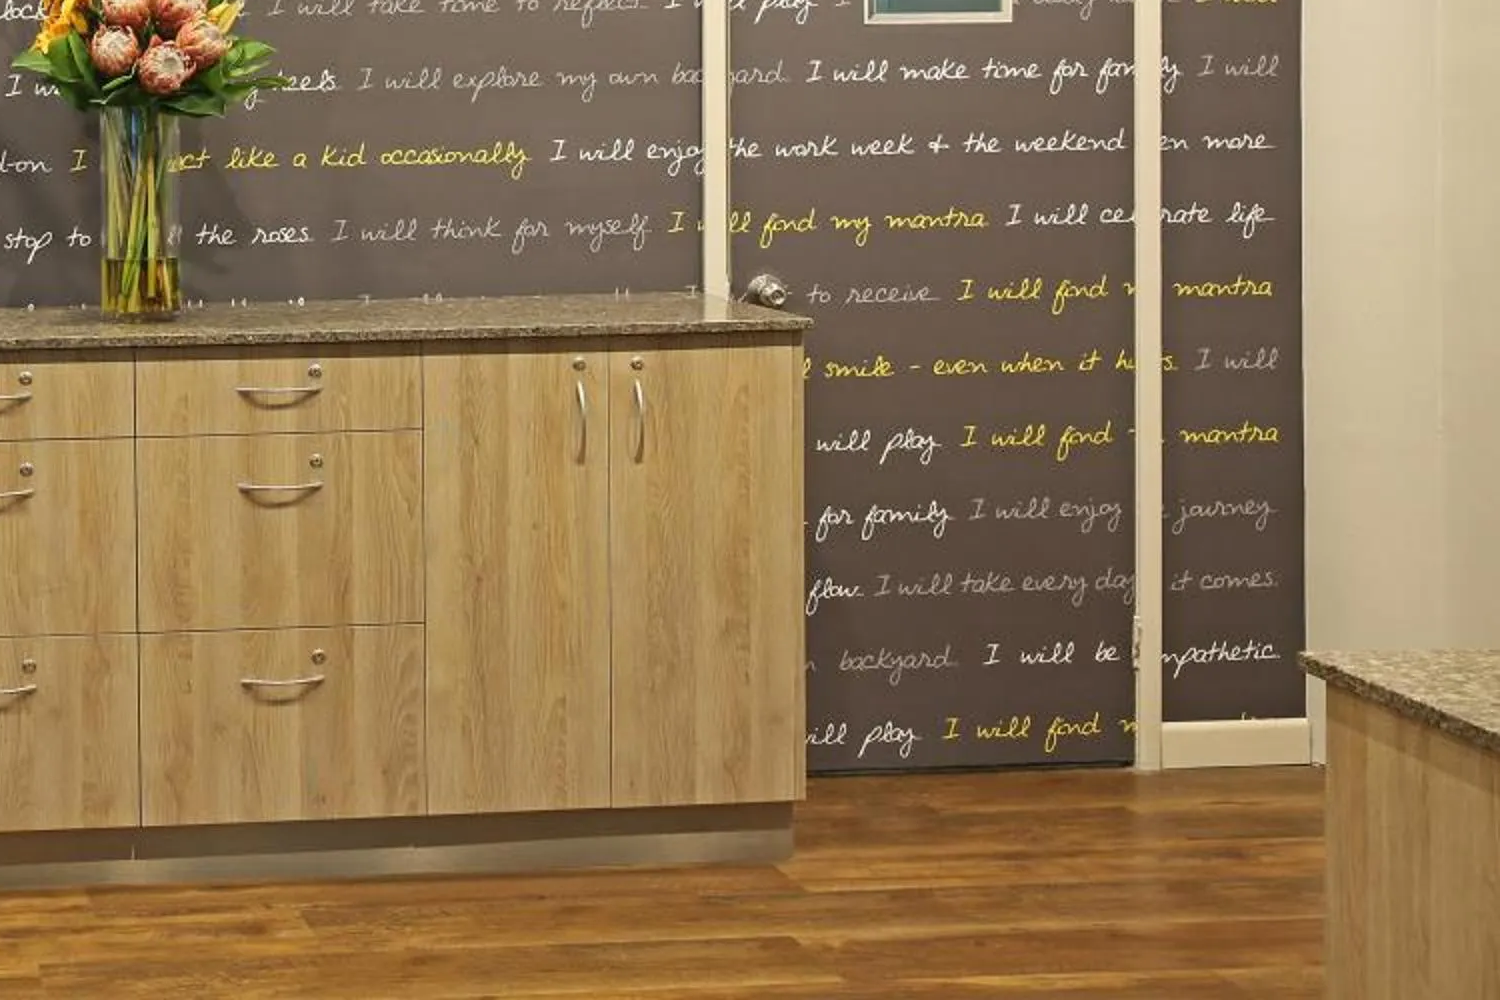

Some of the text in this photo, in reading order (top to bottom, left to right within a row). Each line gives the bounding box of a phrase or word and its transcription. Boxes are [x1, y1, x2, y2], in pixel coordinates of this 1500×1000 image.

[451, 64, 544, 105] explore
[554, 70, 599, 104] my
[607, 70, 660, 86] own
[897, 56, 972, 82] make
[979, 55, 1044, 81] time
[1047, 55, 1091, 98] for
[223, 144, 282, 171] like
[290, 151, 309, 170] a
[774, 133, 841, 159] work
[849, 131, 917, 158] week
[960, 130, 1005, 154] the
[1013, 126, 1128, 154] weekend
[2, 225, 54, 266] stop
[64, 224, 94, 249] to
[194, 221, 239, 247] the
[429, 214, 504, 240] think
[510, 216, 551, 256] for
[758, 206, 819, 250] find
[804, 272, 1110, 317] to find
[822, 346, 1104, 380] smile even when it
[814, 418, 1116, 463] will find
[814, 500, 1124, 544] for enjoy
[872, 569, 1090, 609] I will take every
[981, 638, 1122, 667] I be
[940, 710, 1104, 755] I will find
